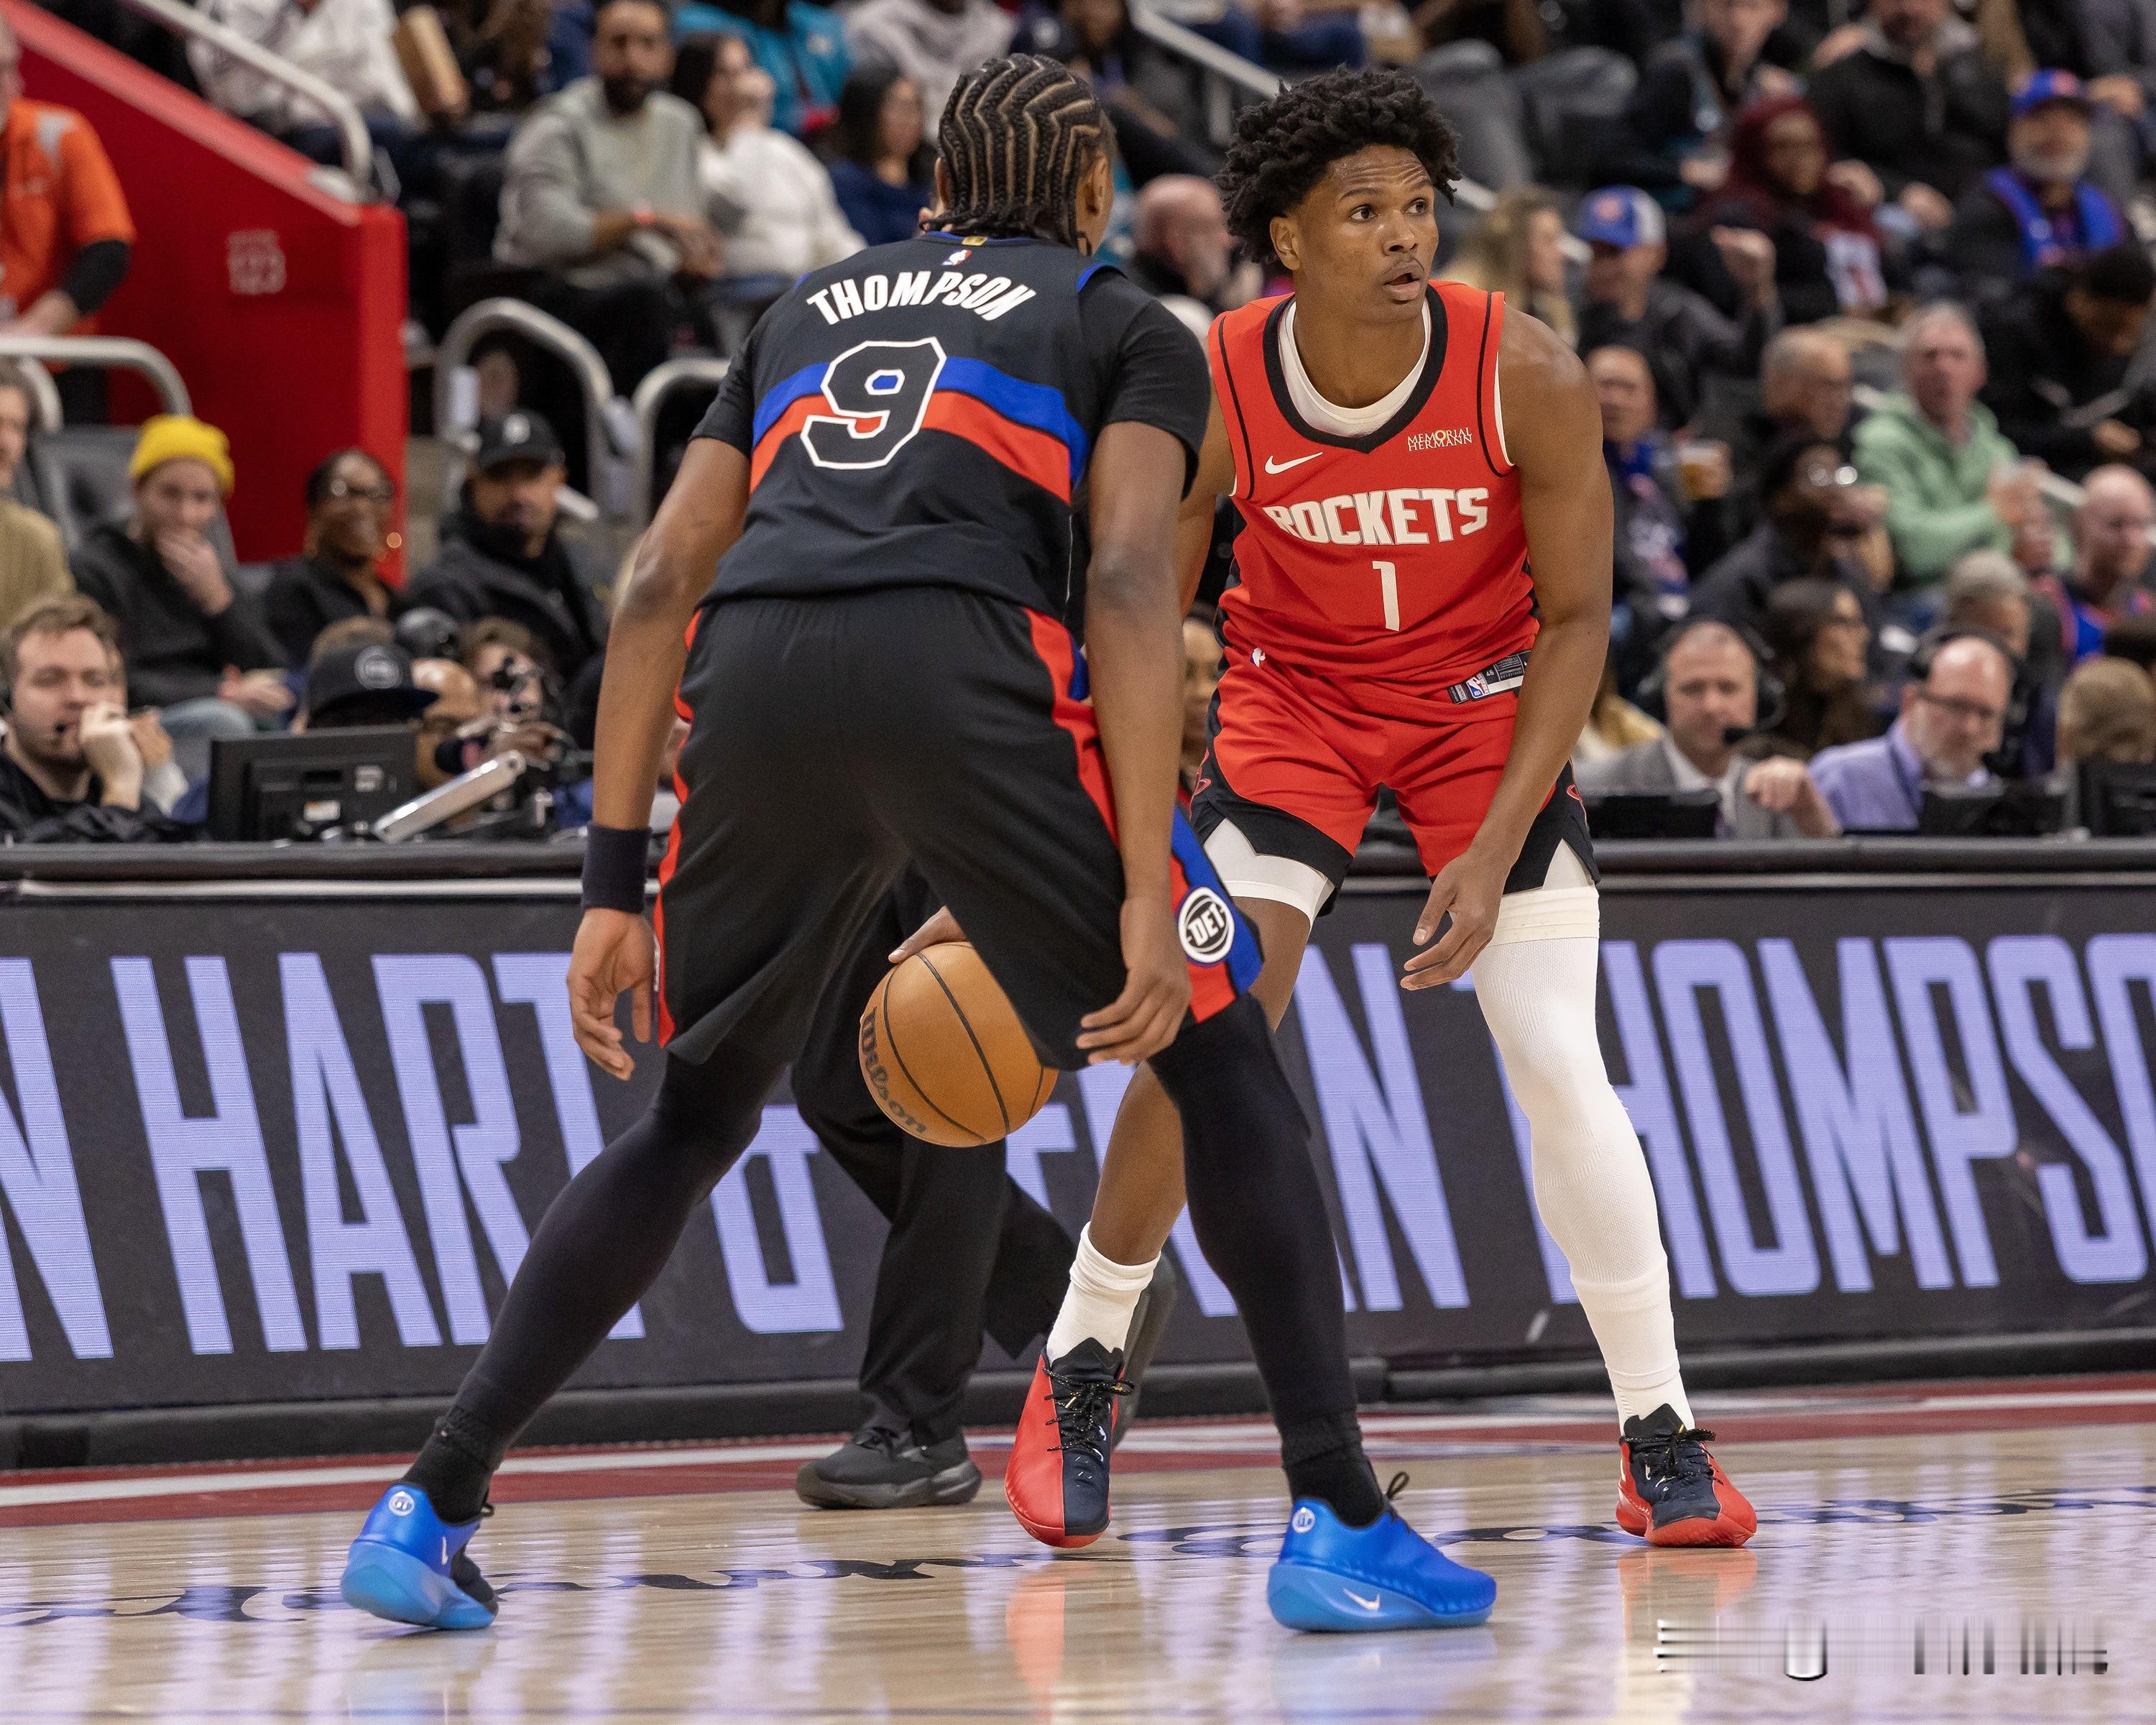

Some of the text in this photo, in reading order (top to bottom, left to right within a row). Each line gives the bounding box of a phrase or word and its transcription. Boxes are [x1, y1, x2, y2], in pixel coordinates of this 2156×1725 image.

[806, 271, 1036, 325] THOMPSON
[800, 336, 947, 470] 9
[1408, 427, 1473, 445] MEMORIAL
[1409, 434, 1473, 451] HERMANN
[1263, 487, 1489, 546] ROCKETS
[1372, 561, 1400, 632] 1
[1187, 903, 1225, 946] DET
[1453, 933, 2156, 1305] HOMPS
